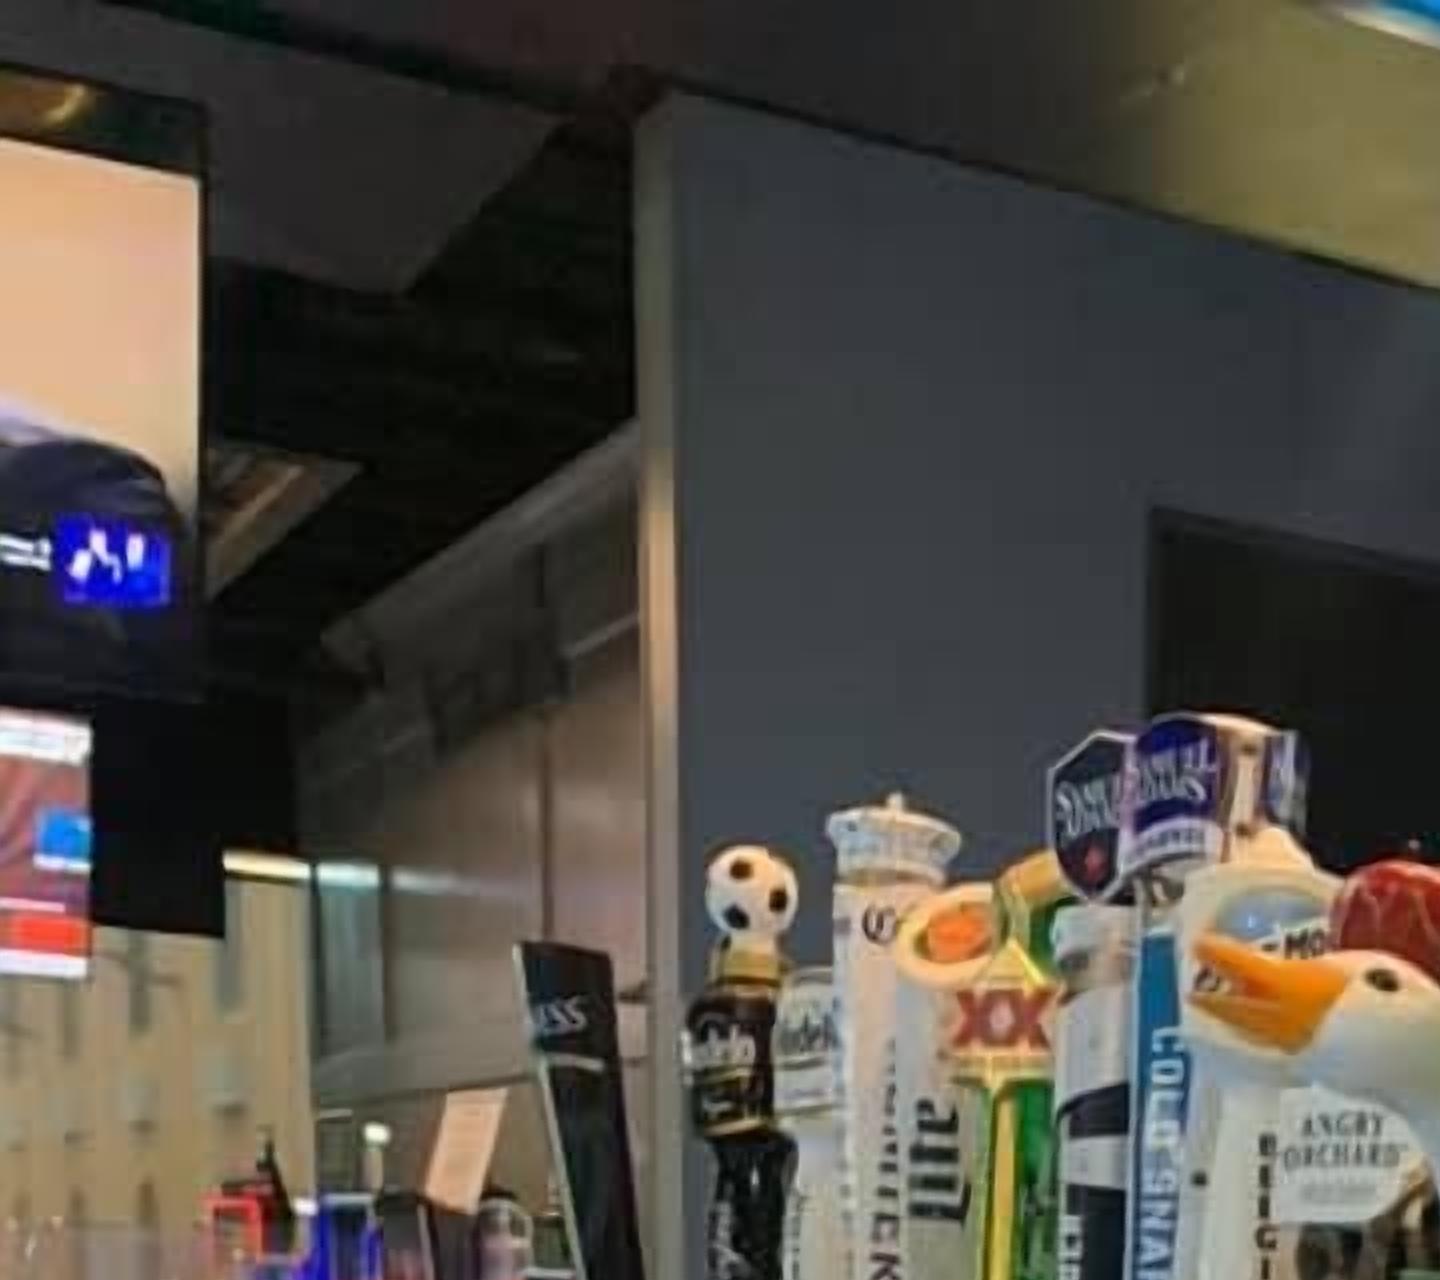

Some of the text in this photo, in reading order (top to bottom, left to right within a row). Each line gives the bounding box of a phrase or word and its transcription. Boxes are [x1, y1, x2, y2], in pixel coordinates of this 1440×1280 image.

[1147, 1026, 1186, 1148] COLD
[1301, 1112, 1384, 1138] ANGRY
[1283, 1143, 1402, 1172] ORCHARD
